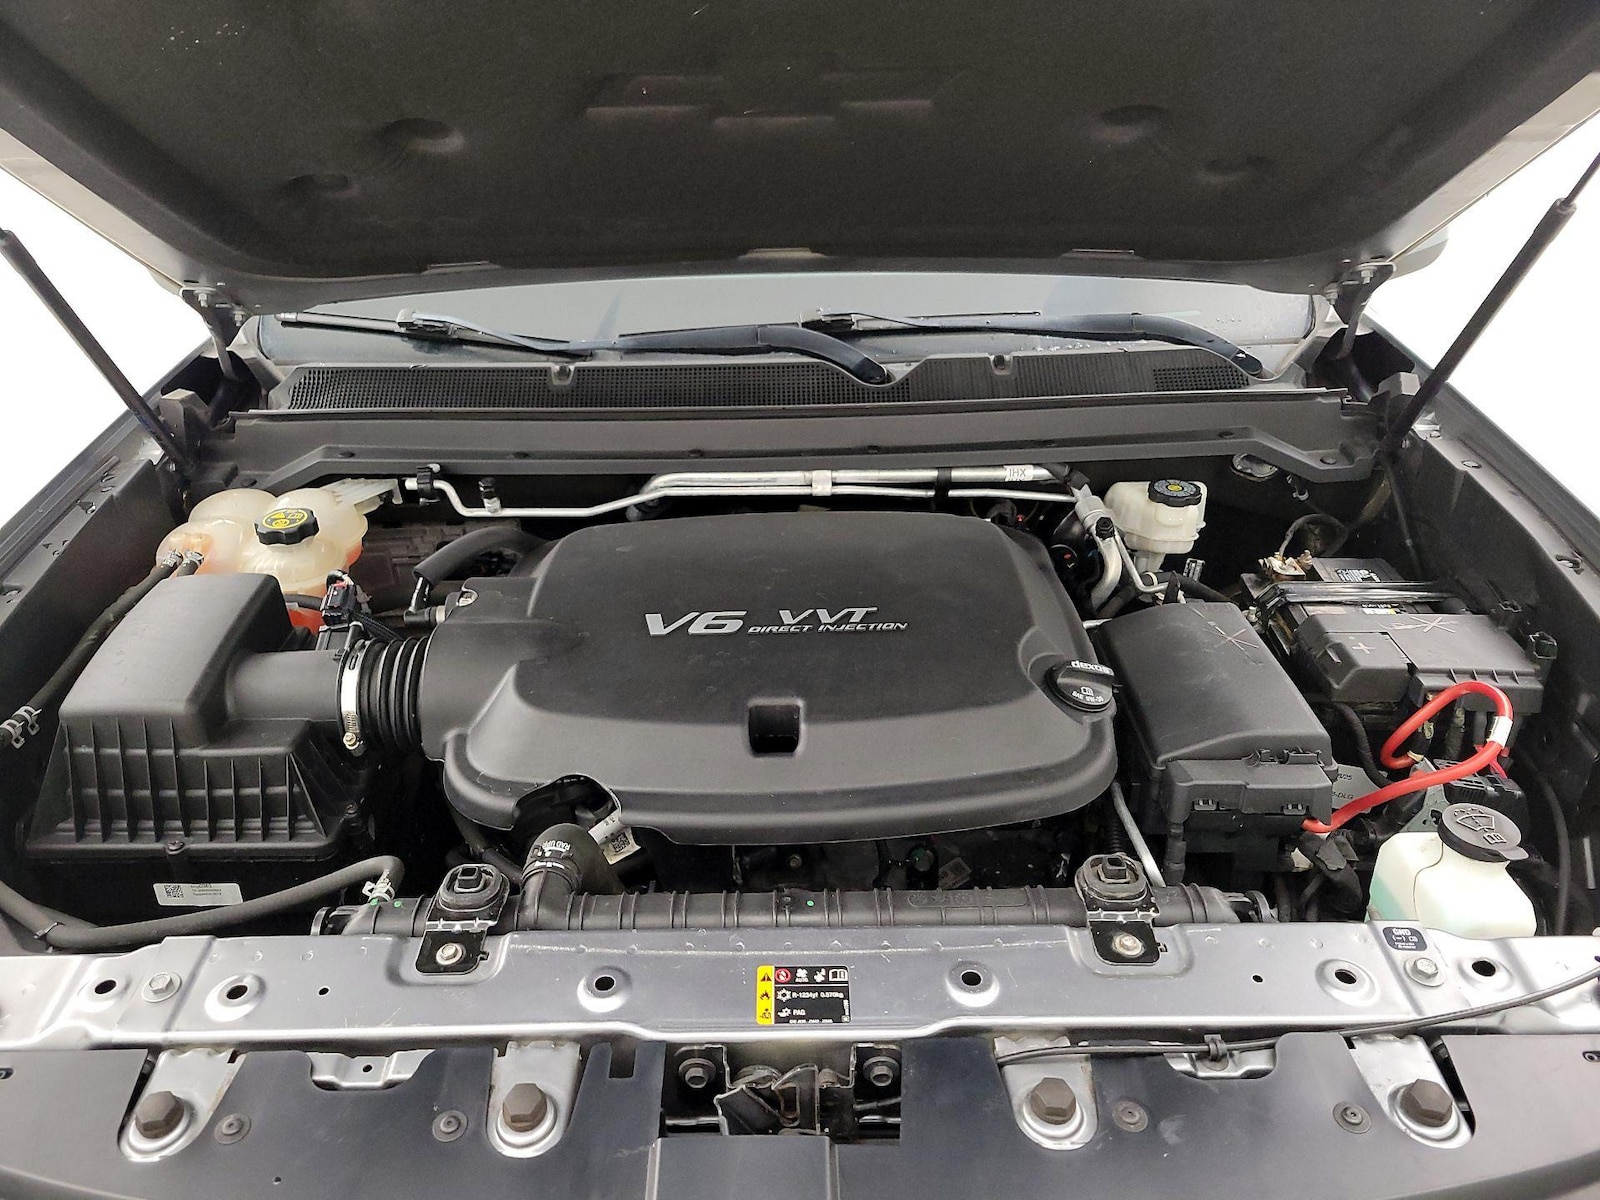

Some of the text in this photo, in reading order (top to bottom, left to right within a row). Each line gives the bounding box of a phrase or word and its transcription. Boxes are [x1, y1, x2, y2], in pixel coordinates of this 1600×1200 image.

[645, 607, 878, 636] V6 VVT
[747, 622, 909, 635] DIRECT INJECTION
